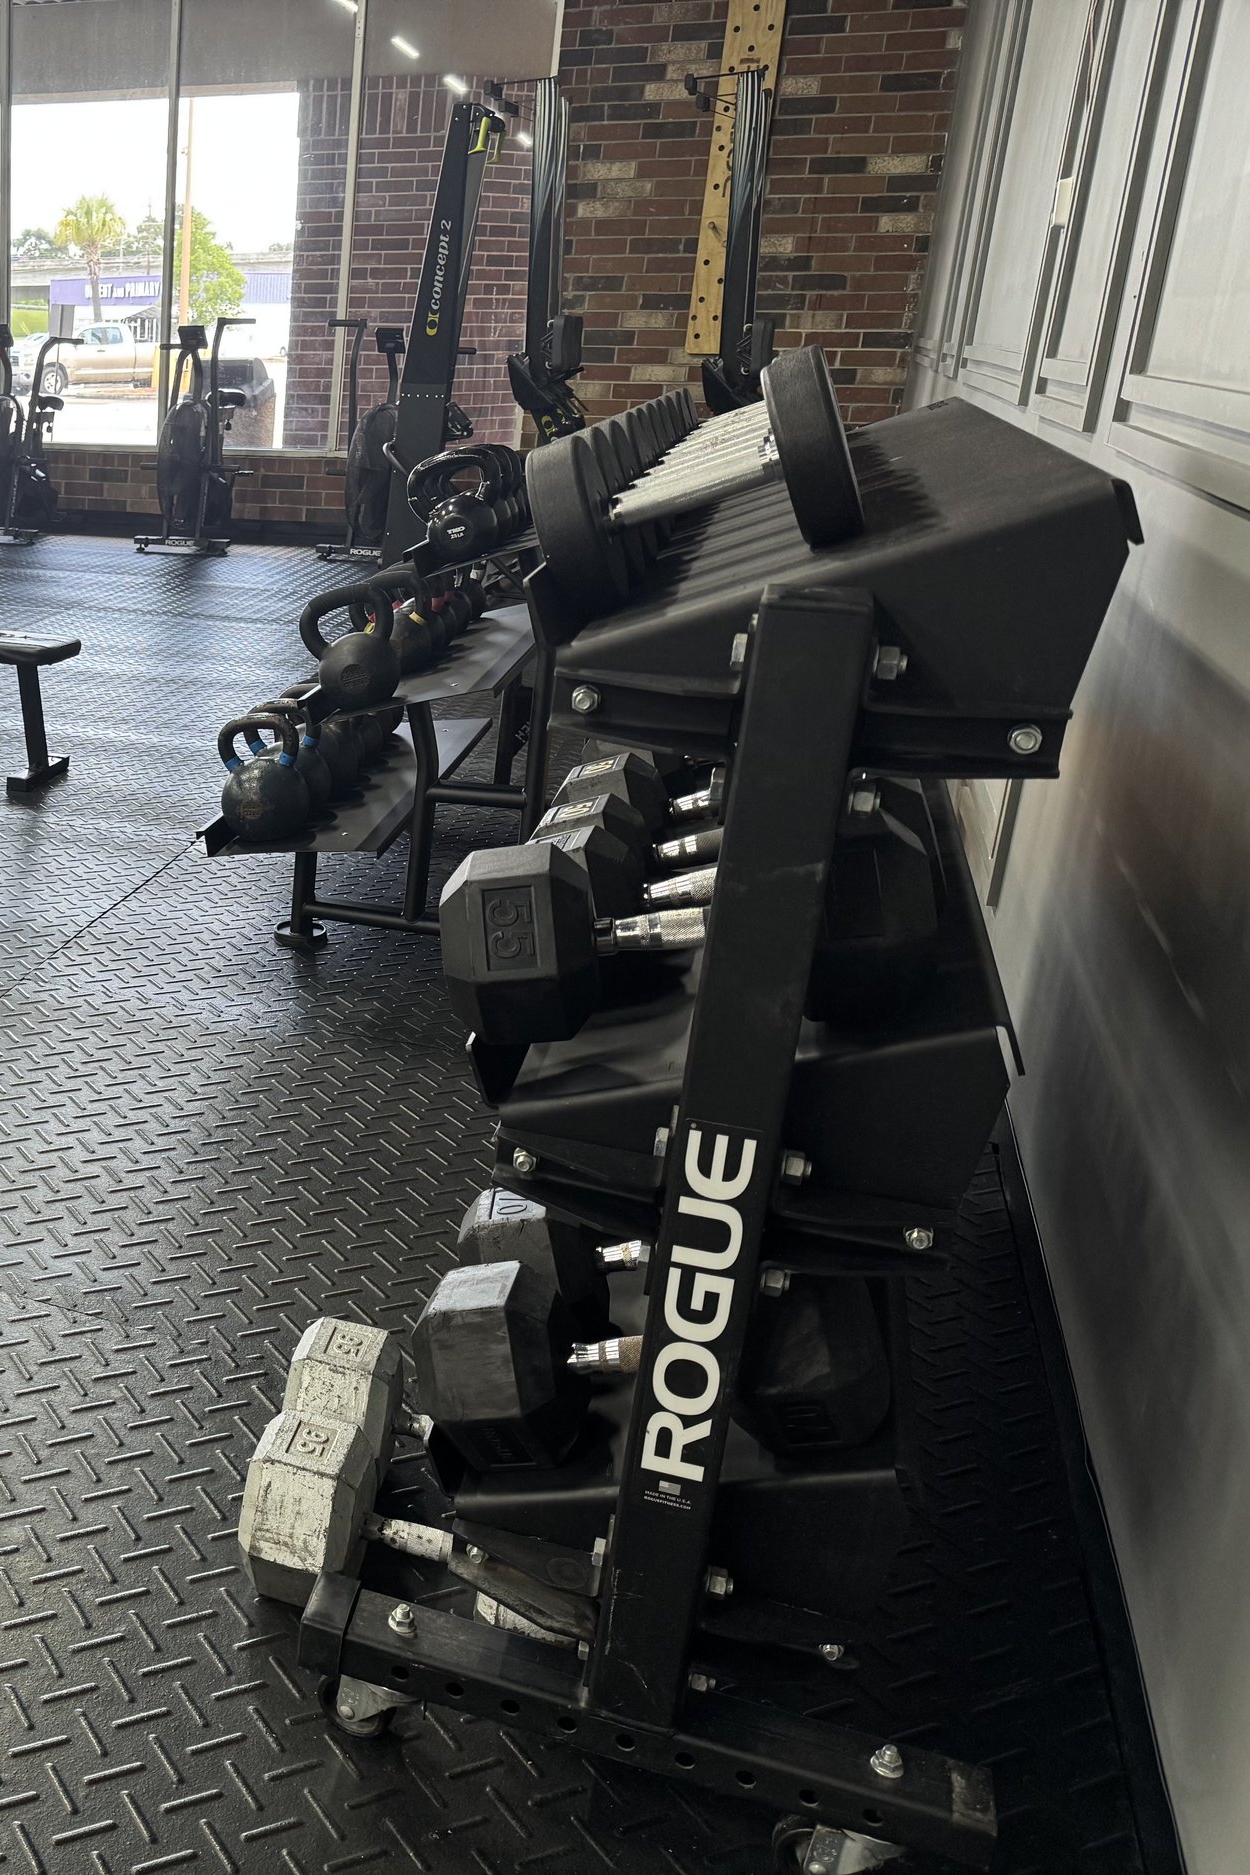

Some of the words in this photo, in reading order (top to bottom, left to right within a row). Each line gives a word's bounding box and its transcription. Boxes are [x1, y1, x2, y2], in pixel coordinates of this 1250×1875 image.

[85, 283, 113, 299] UENT
[164, 539, 195, 547] ROGUE
[349, 548, 382, 557] ROGUE
[487, 899, 535, 959] 55
[640, 1129, 757, 1482] ROGUE
